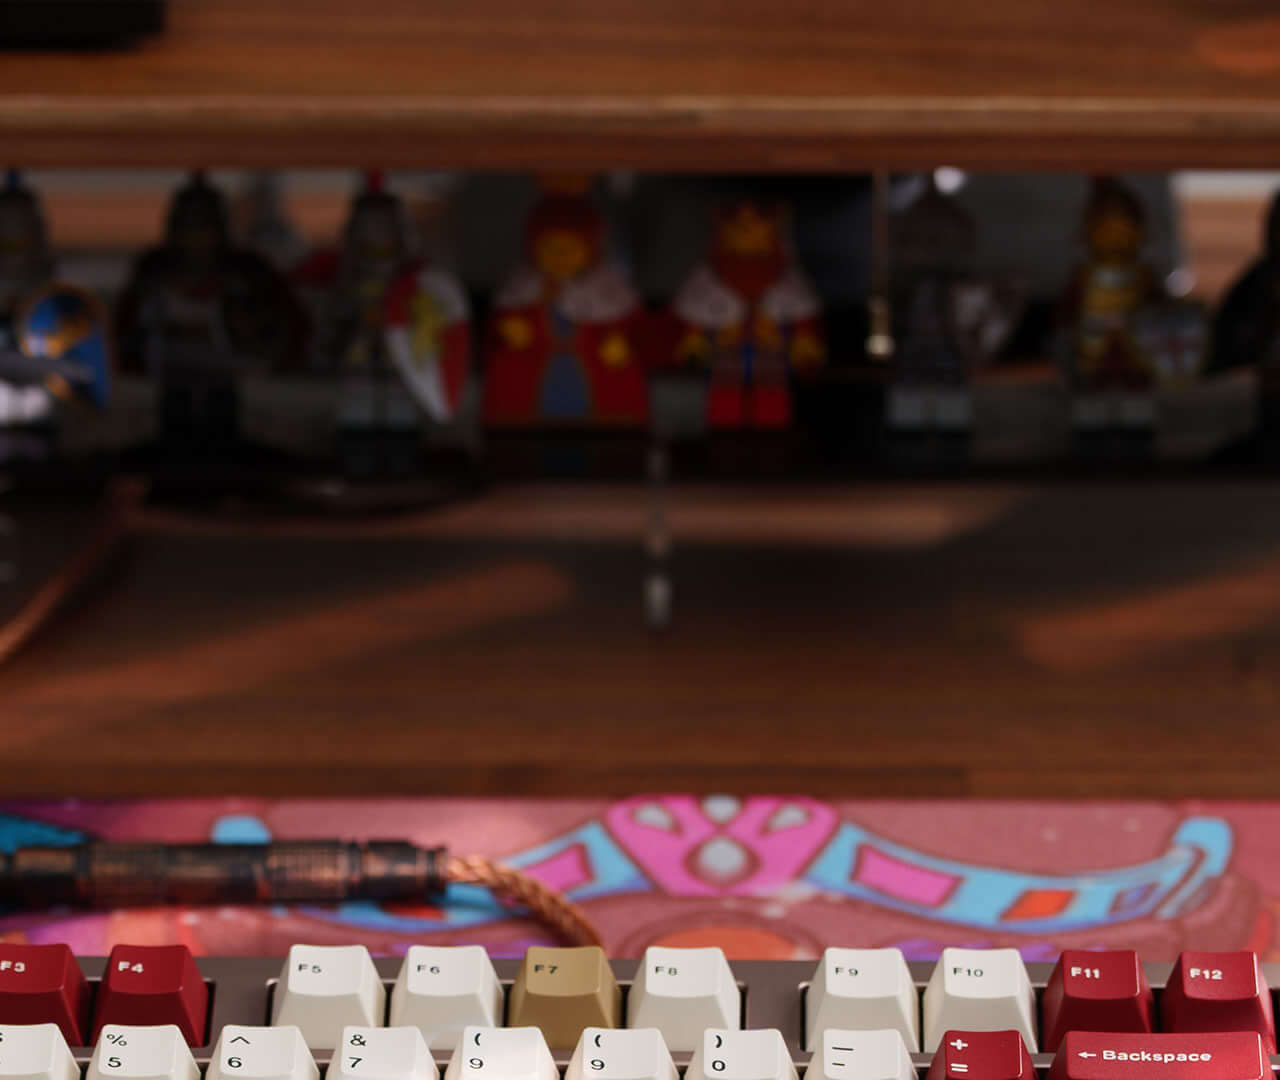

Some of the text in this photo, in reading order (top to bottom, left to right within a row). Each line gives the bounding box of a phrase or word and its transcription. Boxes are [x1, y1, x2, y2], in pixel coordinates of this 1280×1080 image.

[0, 960, 25, 973] F3
[117, 961, 144, 973] F4
[297, 963, 322, 973] F5
[416, 964, 441, 974] F6
[534, 964, 558, 975] F7
[654, 965, 678, 976] F8
[835, 967, 859, 976] F9
[953, 967, 984, 977] F10
[1070, 966, 1100, 979] F11
[1189, 967, 1223, 980] F12
[107, 1056, 122, 1068] 5
[227, 1056, 243, 1069] 6
[349, 1056, 363, 1069] 7
[1102, 1050, 1212, 1064] Backspace
[469, 1057, 484, 1070] 9
[590, 1059, 605, 1071] 9
[711, 1060, 726, 1072] 0
